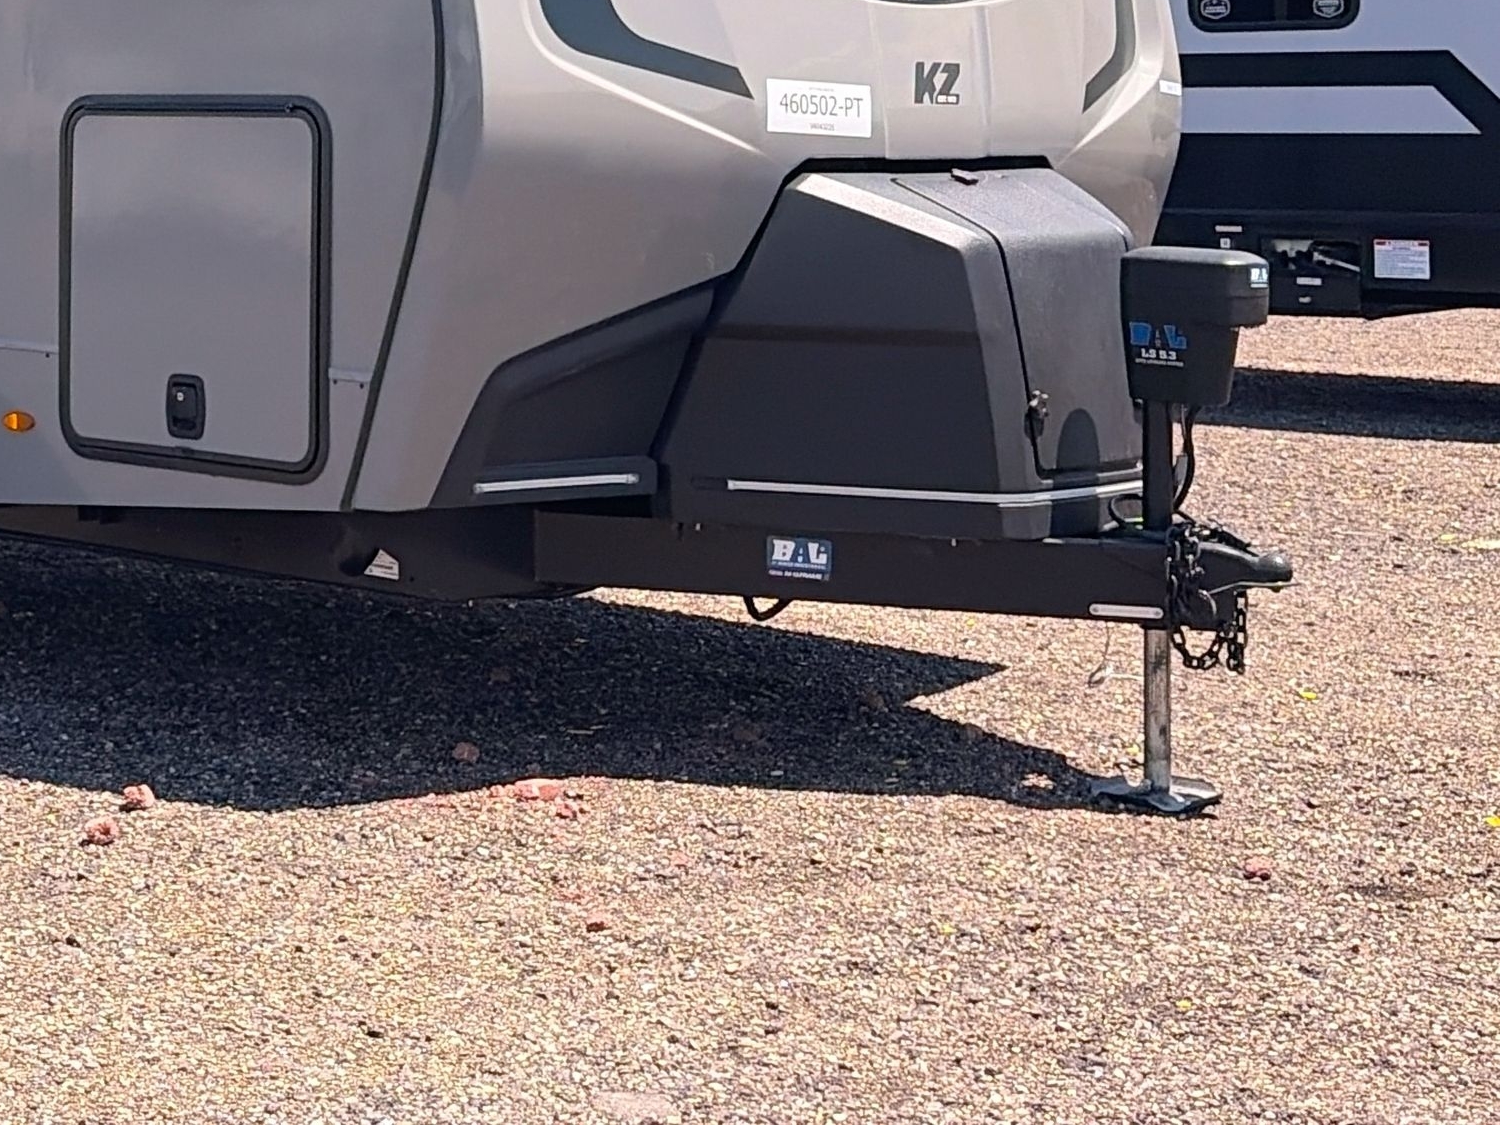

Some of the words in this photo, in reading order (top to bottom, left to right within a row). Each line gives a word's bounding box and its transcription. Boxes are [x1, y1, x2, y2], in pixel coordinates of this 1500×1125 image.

[914, 61, 960, 105] KZ
[779, 93, 864, 118] 460502-PT
[771, 539, 828, 564] BAL
